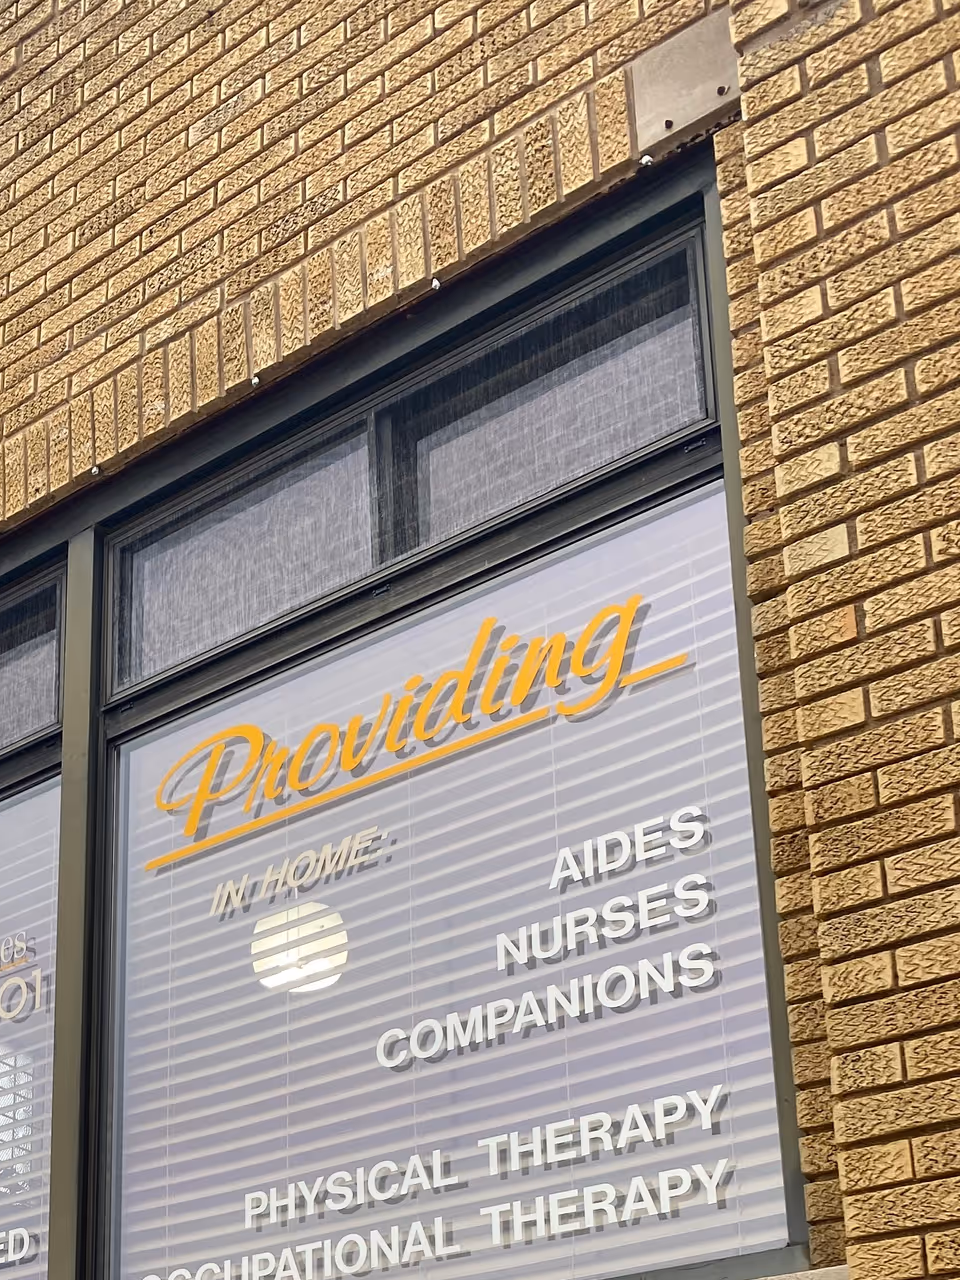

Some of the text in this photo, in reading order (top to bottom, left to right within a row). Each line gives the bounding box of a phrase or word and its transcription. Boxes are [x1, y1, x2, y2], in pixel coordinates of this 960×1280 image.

[154, 594, 645, 837] Providing
[209, 825, 389, 916] IN HOME:
[549, 806, 706, 889] AIDES
[497, 873, 709, 971] NURSES
[376, 943, 713, 1068] COMPANIONS
[245, 1085, 723, 1229] PHYSICAL THERAPY
[480, 1159, 728, 1246] THERAPY
